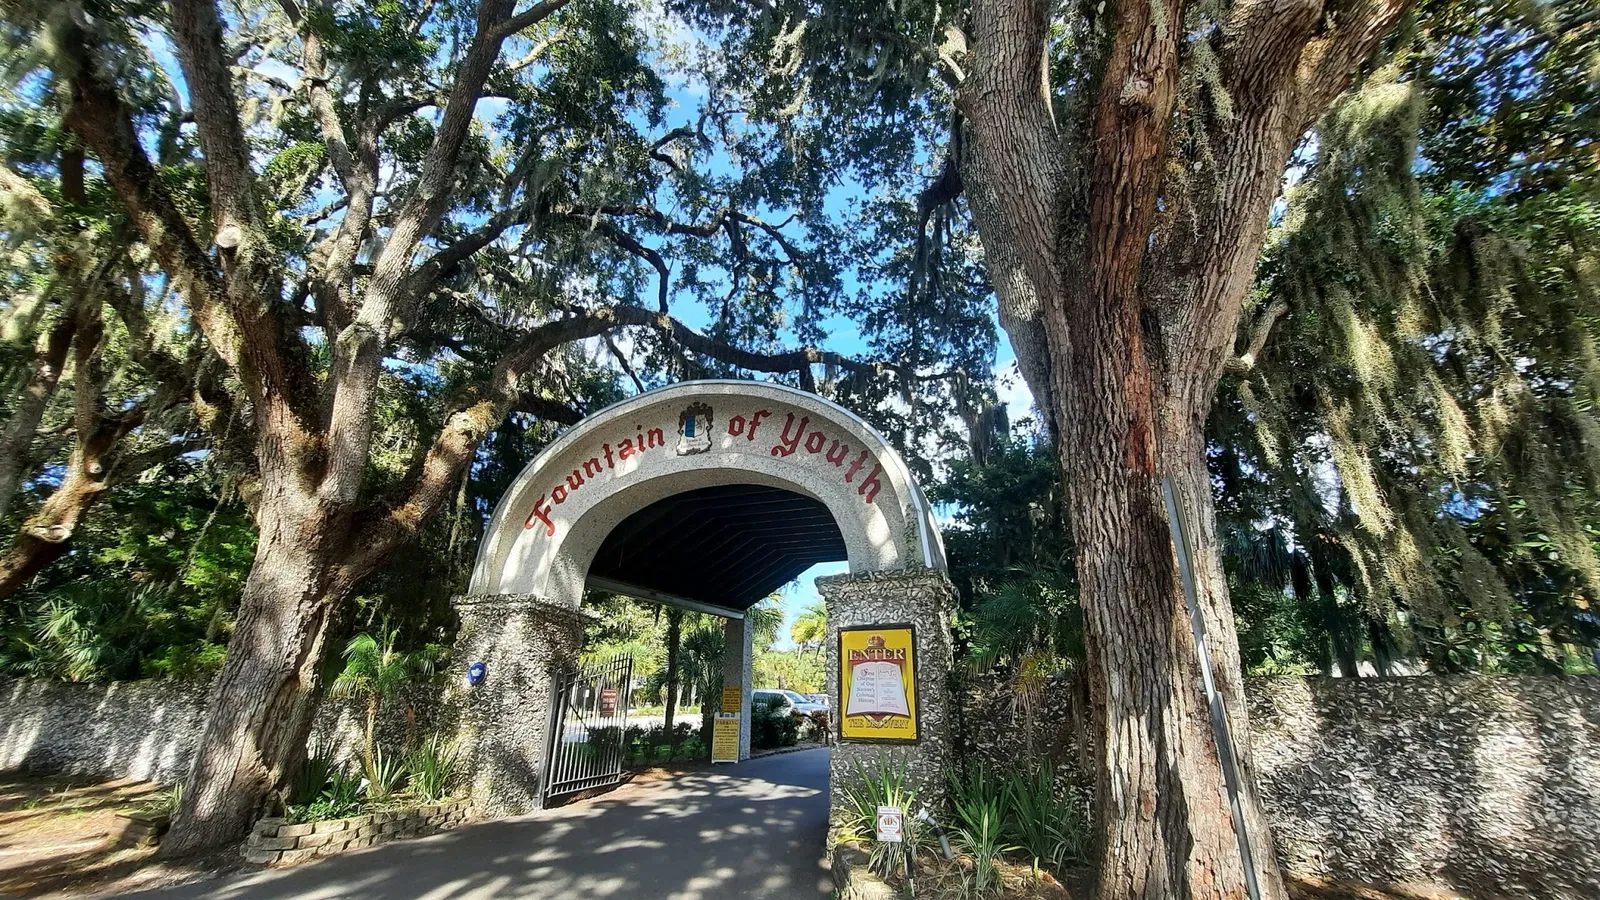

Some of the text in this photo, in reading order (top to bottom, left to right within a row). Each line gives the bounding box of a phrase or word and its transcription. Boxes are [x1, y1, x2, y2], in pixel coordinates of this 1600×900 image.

[524, 409, 883, 537] Fountain of Youth
[849, 648, 905, 660] ENTER
[848, 719, 864, 728] THE
[882, 818, 898, 826] ADS
